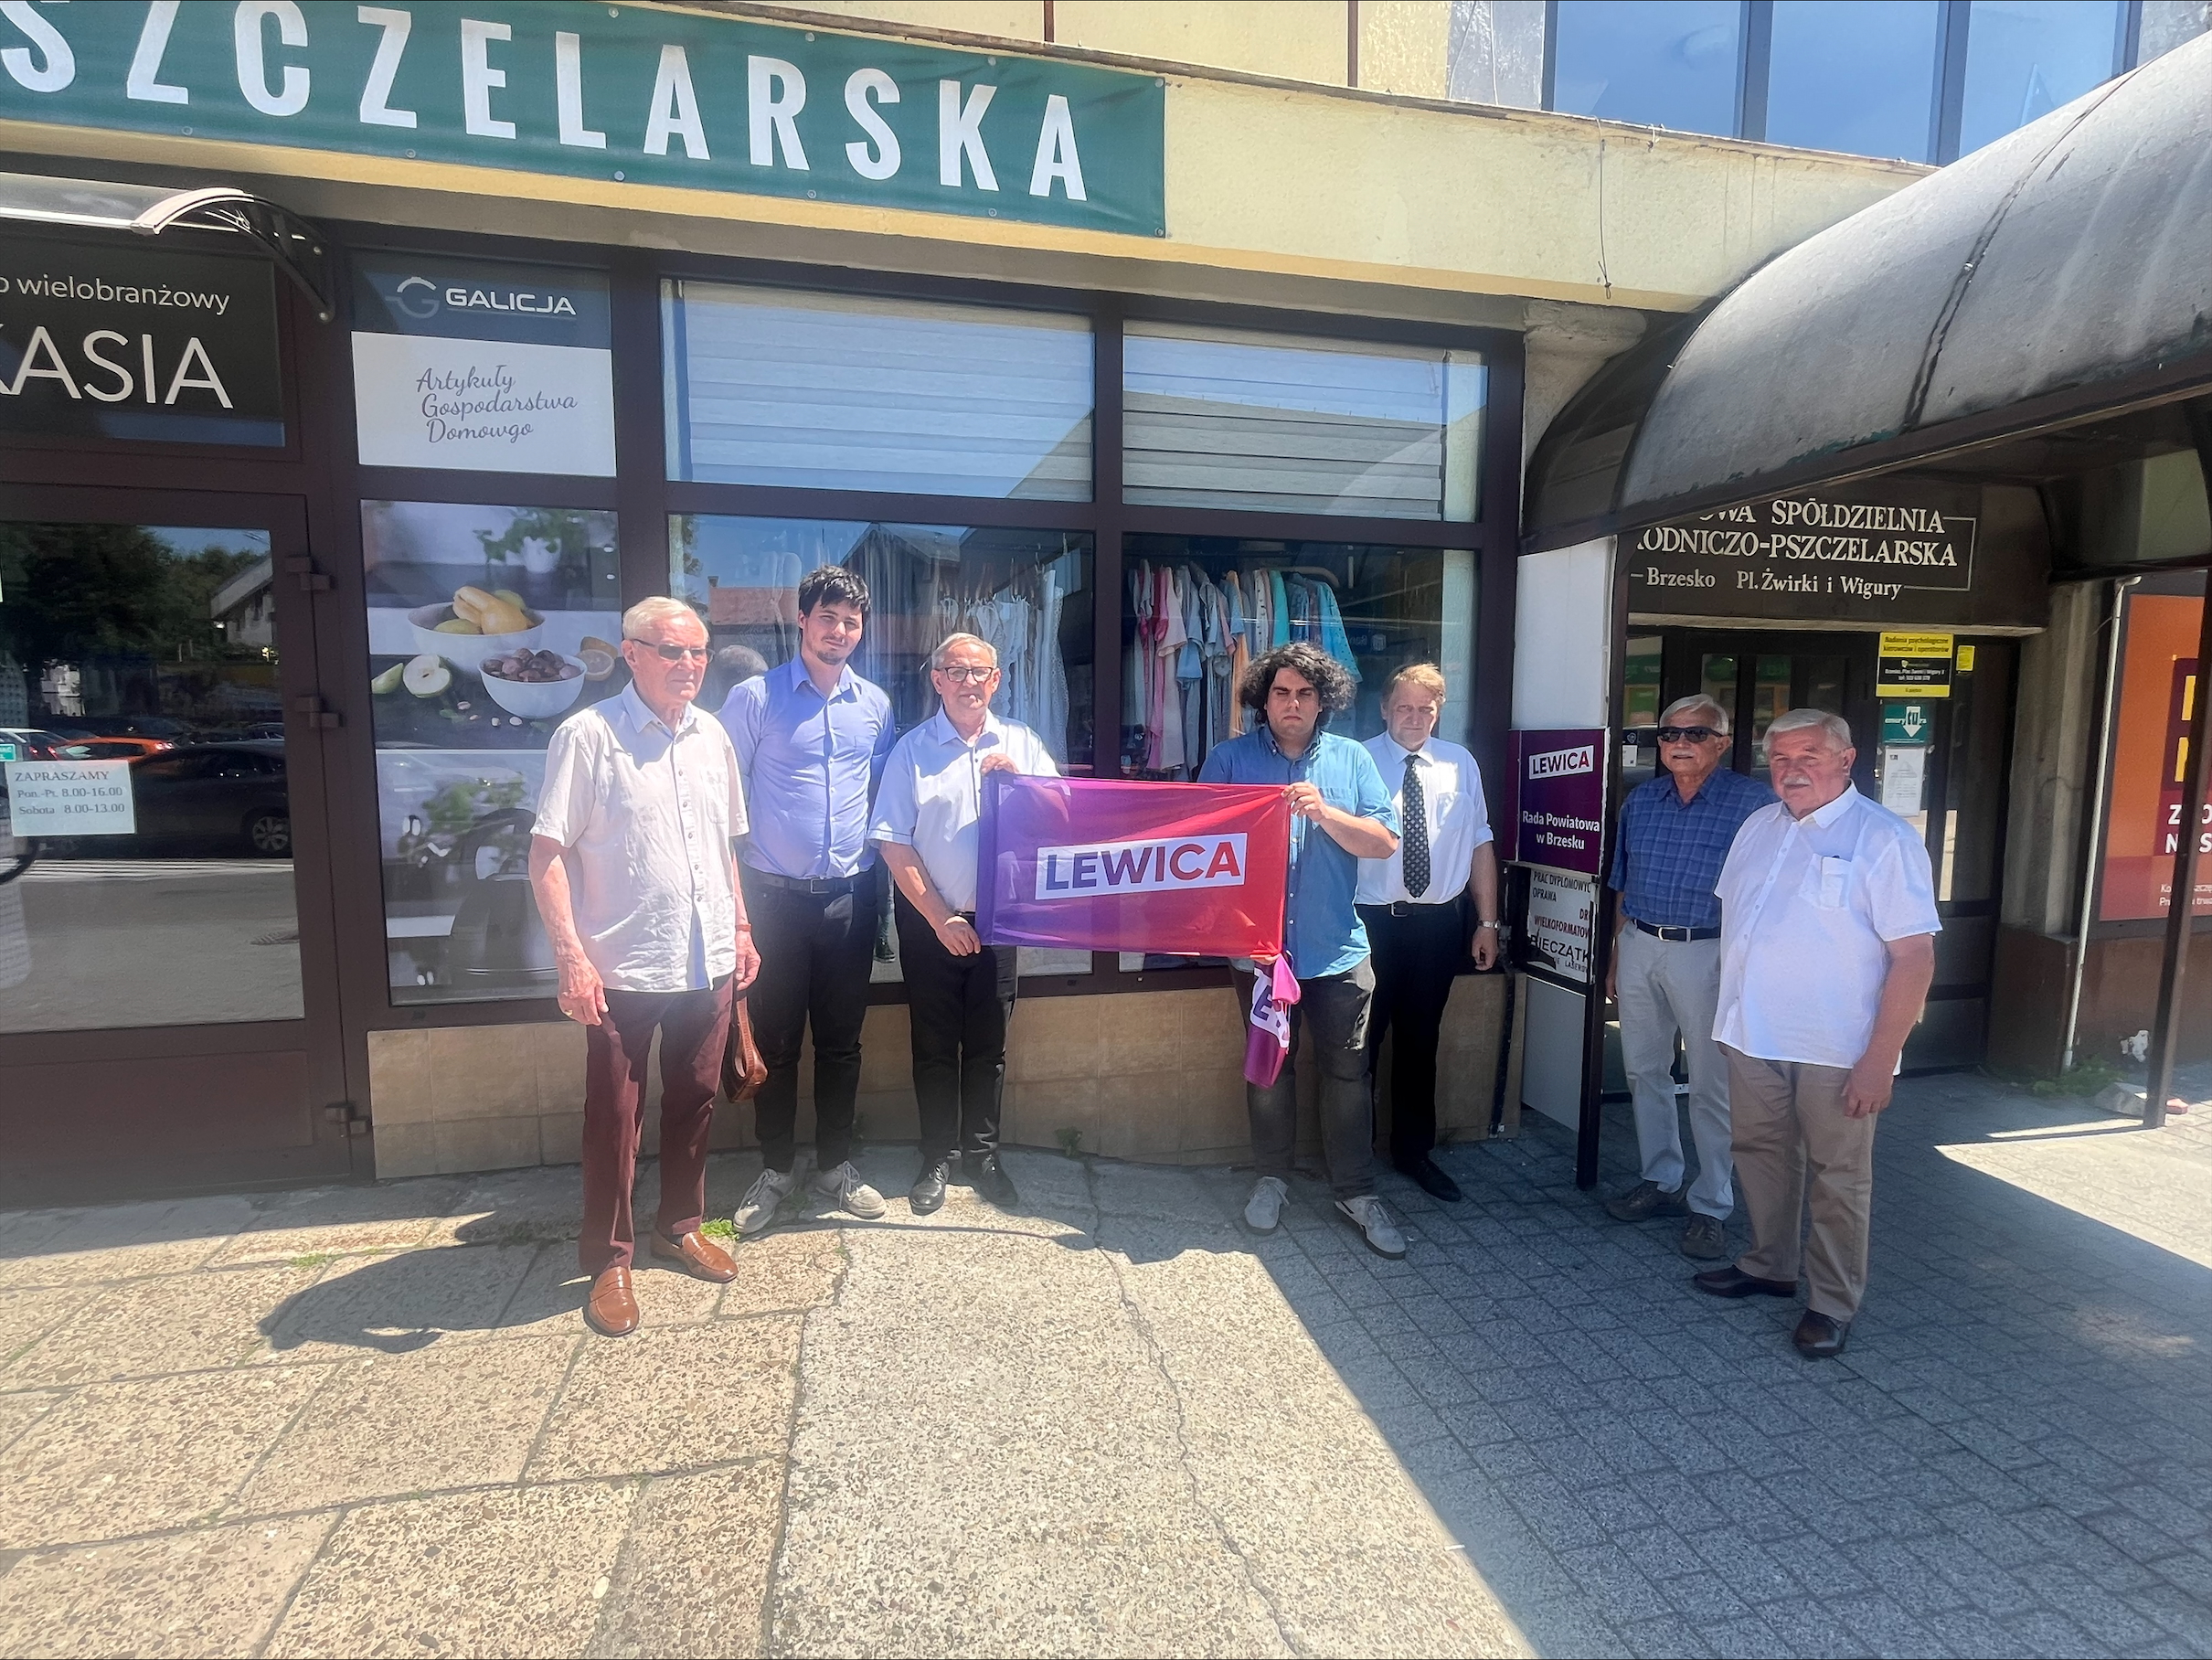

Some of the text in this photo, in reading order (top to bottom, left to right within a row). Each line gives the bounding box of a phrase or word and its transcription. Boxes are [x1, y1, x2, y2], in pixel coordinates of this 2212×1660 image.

[16, 273, 229, 315] wielobranżowy
[445, 287, 577, 315] GALICJA
[416, 364, 516, 396] Artykuły
[421, 389, 578, 421] Gospodarstwa
[426, 418, 534, 443] Domowgo
[1637, 527, 1958, 567] ODNICZO-PSZCZELARSKA
[1646, 566, 1716, 588] Brzesko
[1760, 567, 1819, 593] Żwirki
[1827, 576, 1834, 593] i
[1840, 575, 1903, 601] Wigury
[1532, 750, 1590, 775] LEWICA
[15, 771, 110, 782] ZAPRASZAMY
[61, 787, 123, 797] 8.00-16.00
[19, 803, 125, 815] Sobota 8.00-13.00
[1522, 810, 1601, 832] Rada Powiatowa
[1536, 831, 1585, 850] w Brzesku
[1045, 841, 1241, 891] LEWICA
[1532, 887, 1557, 902] OPRAWA
